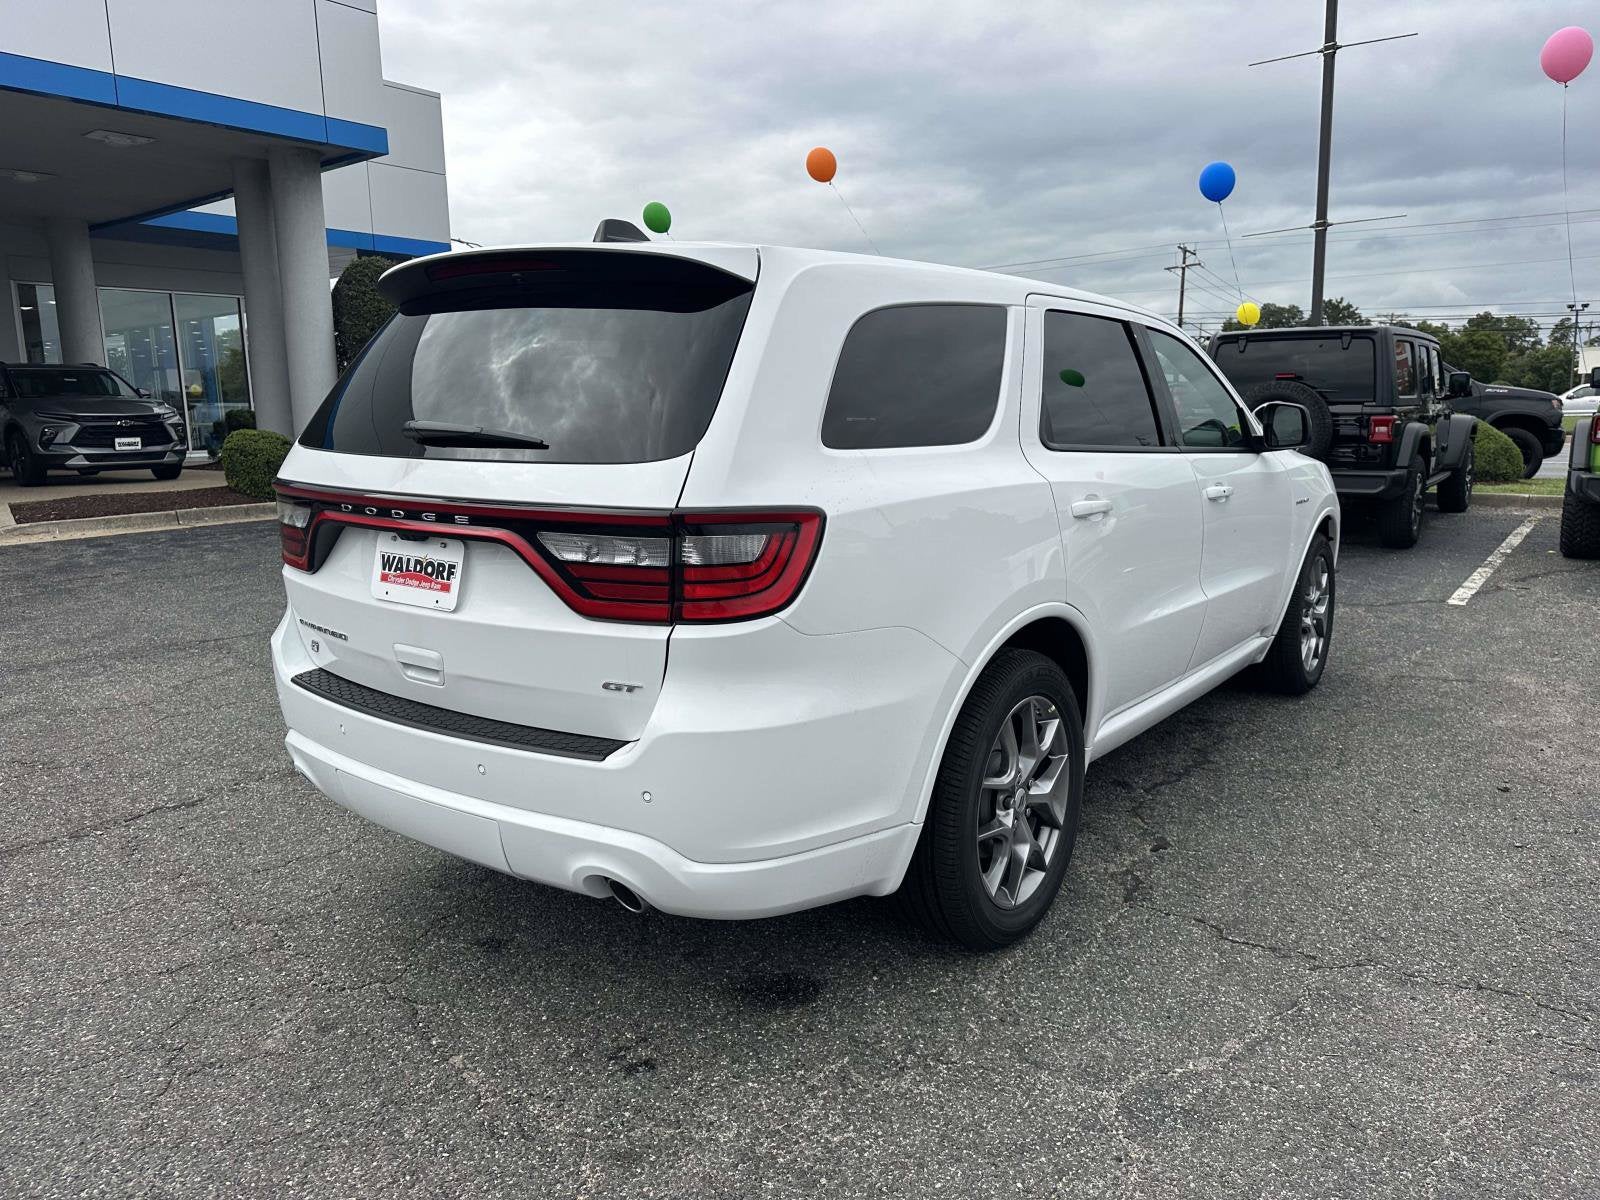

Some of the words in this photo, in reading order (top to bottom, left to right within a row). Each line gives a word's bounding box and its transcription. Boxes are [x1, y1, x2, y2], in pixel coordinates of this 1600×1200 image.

[341, 503, 470, 525] DODGE
[381, 553, 458, 581] WALDORF
[388, 574, 405, 584] Chrysler
[406, 578, 419, 586] Dodge
[419, 580, 430, 588] Jeep
[431, 582, 441, 590] Ram
[299, 618, 349, 641] DURANGO
[601, 682, 644, 693] GT
